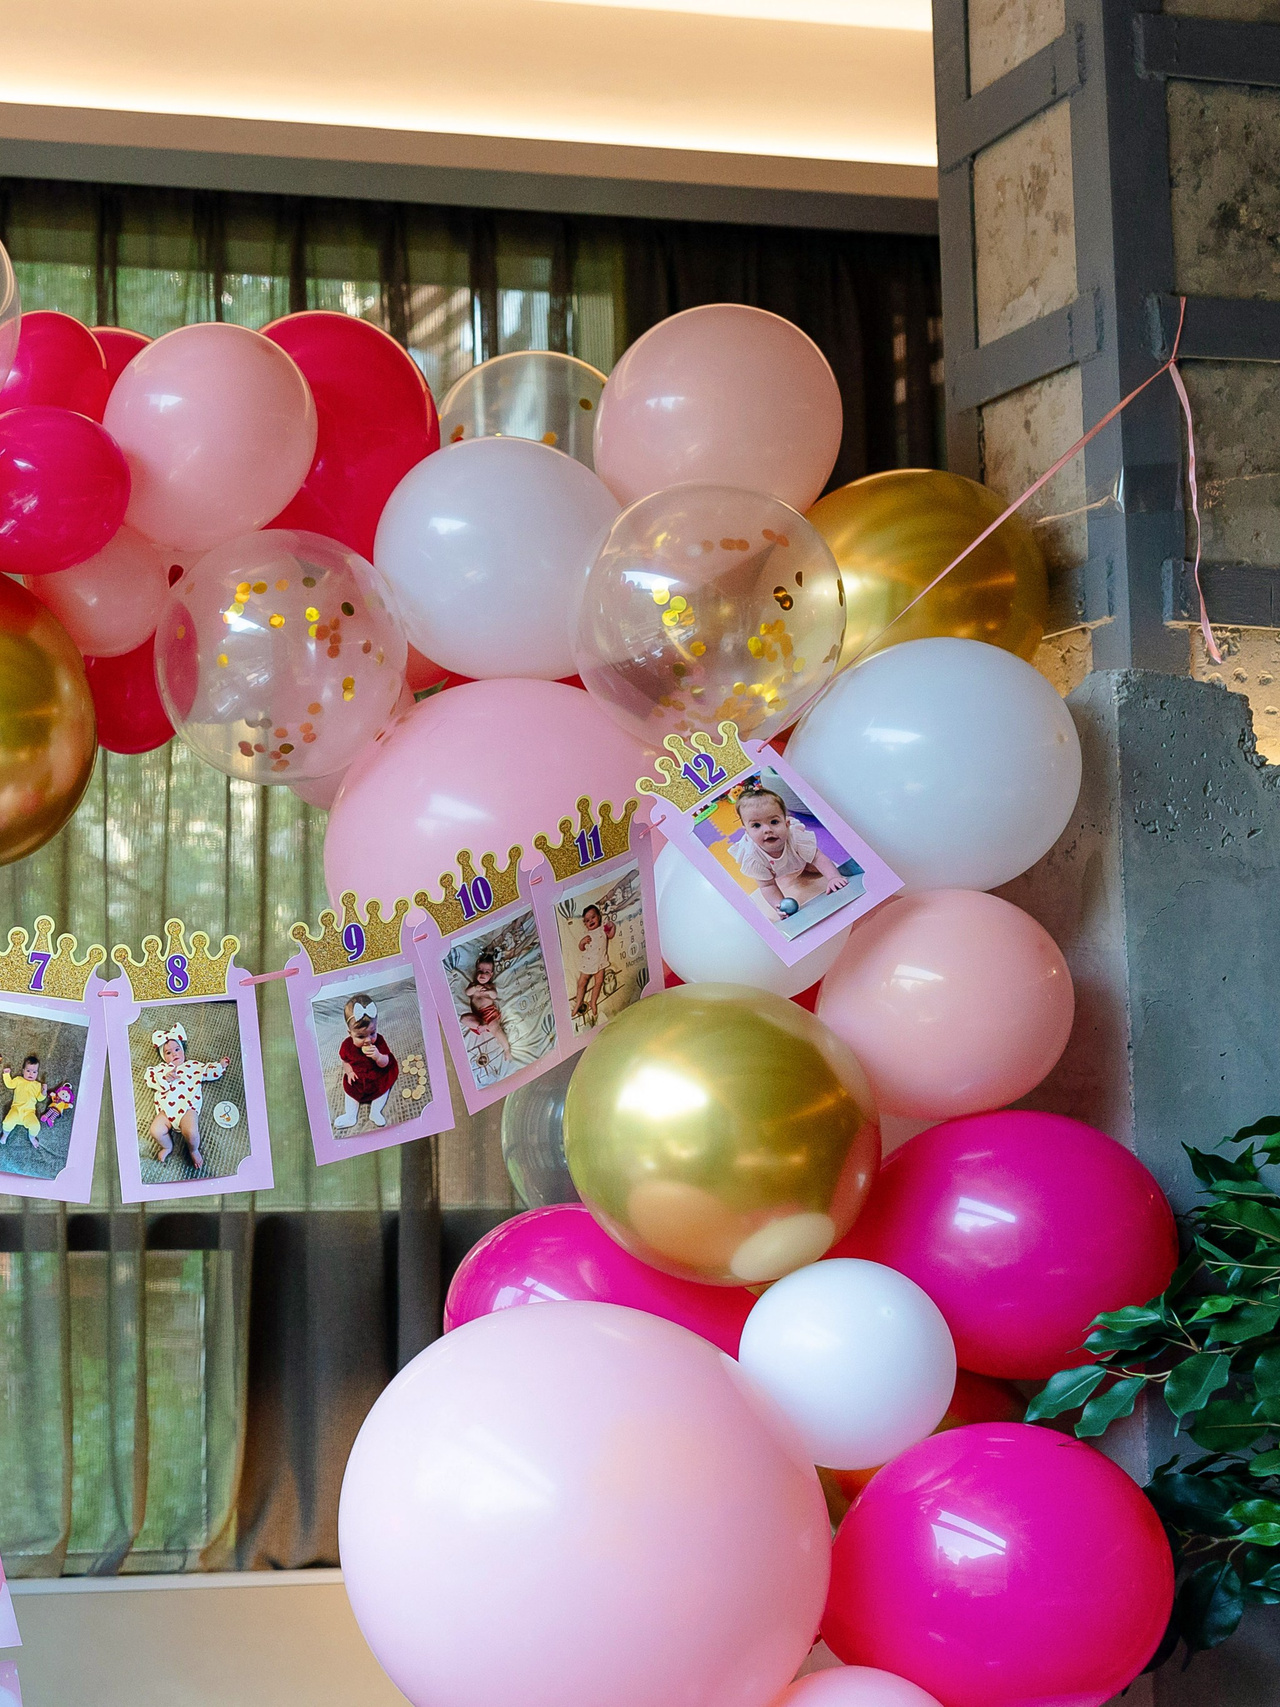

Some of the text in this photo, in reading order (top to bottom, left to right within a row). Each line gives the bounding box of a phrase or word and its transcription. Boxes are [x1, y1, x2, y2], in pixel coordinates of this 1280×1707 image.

[681, 752, 727, 793] 12
[574, 823, 605, 866] 11
[455, 876, 493, 920] 10
[343, 923, 366, 962] 9
[29, 951, 52, 991] 7
[166, 954, 190, 993] 8
